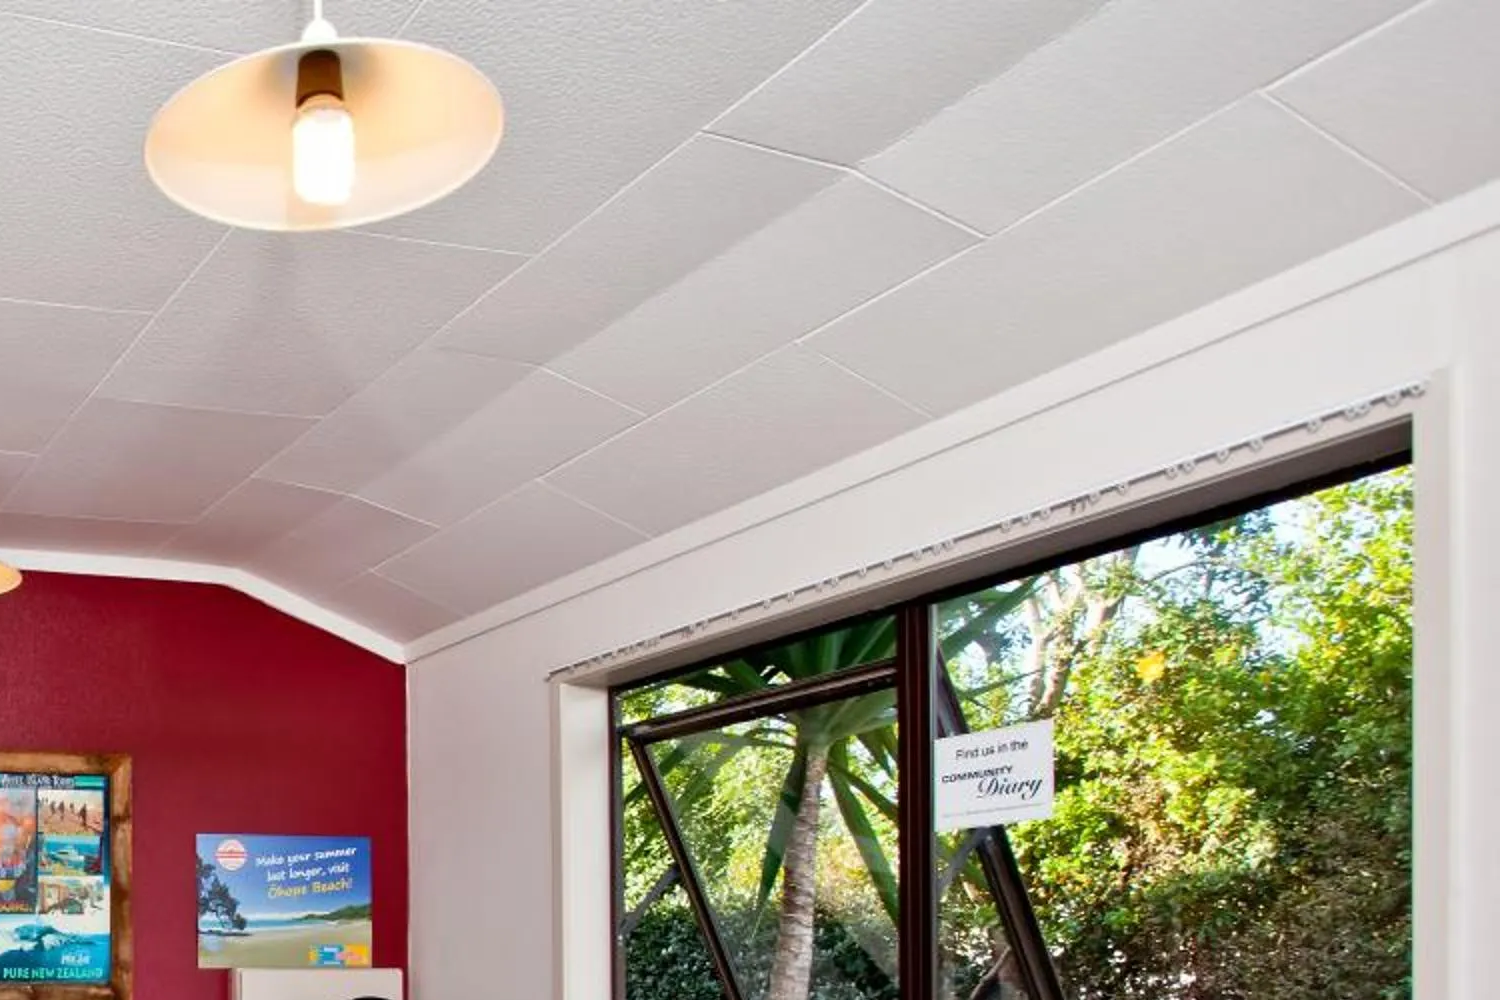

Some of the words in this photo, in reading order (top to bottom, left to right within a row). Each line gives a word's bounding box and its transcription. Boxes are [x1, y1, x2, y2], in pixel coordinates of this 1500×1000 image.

[955, 748, 979, 759] Find
[982, 746, 995, 757] us
[997, 743, 1009, 753] in
[1010, 740, 1029, 752] the
[942, 765, 1013, 784] COMMUNITY
[976, 777, 1043, 800] Diary
[255, 855, 285, 867] Make
[287, 853, 311, 867] your
[314, 847, 357, 861] summer
[289, 867, 327, 882] longer,
[329, 862, 351, 875] visit
[312, 878, 354, 894] Beach!
[3, 967, 30, 980] PURE
[32, 968, 55, 980] NEW
[56, 967, 105, 980] ZEALAND
